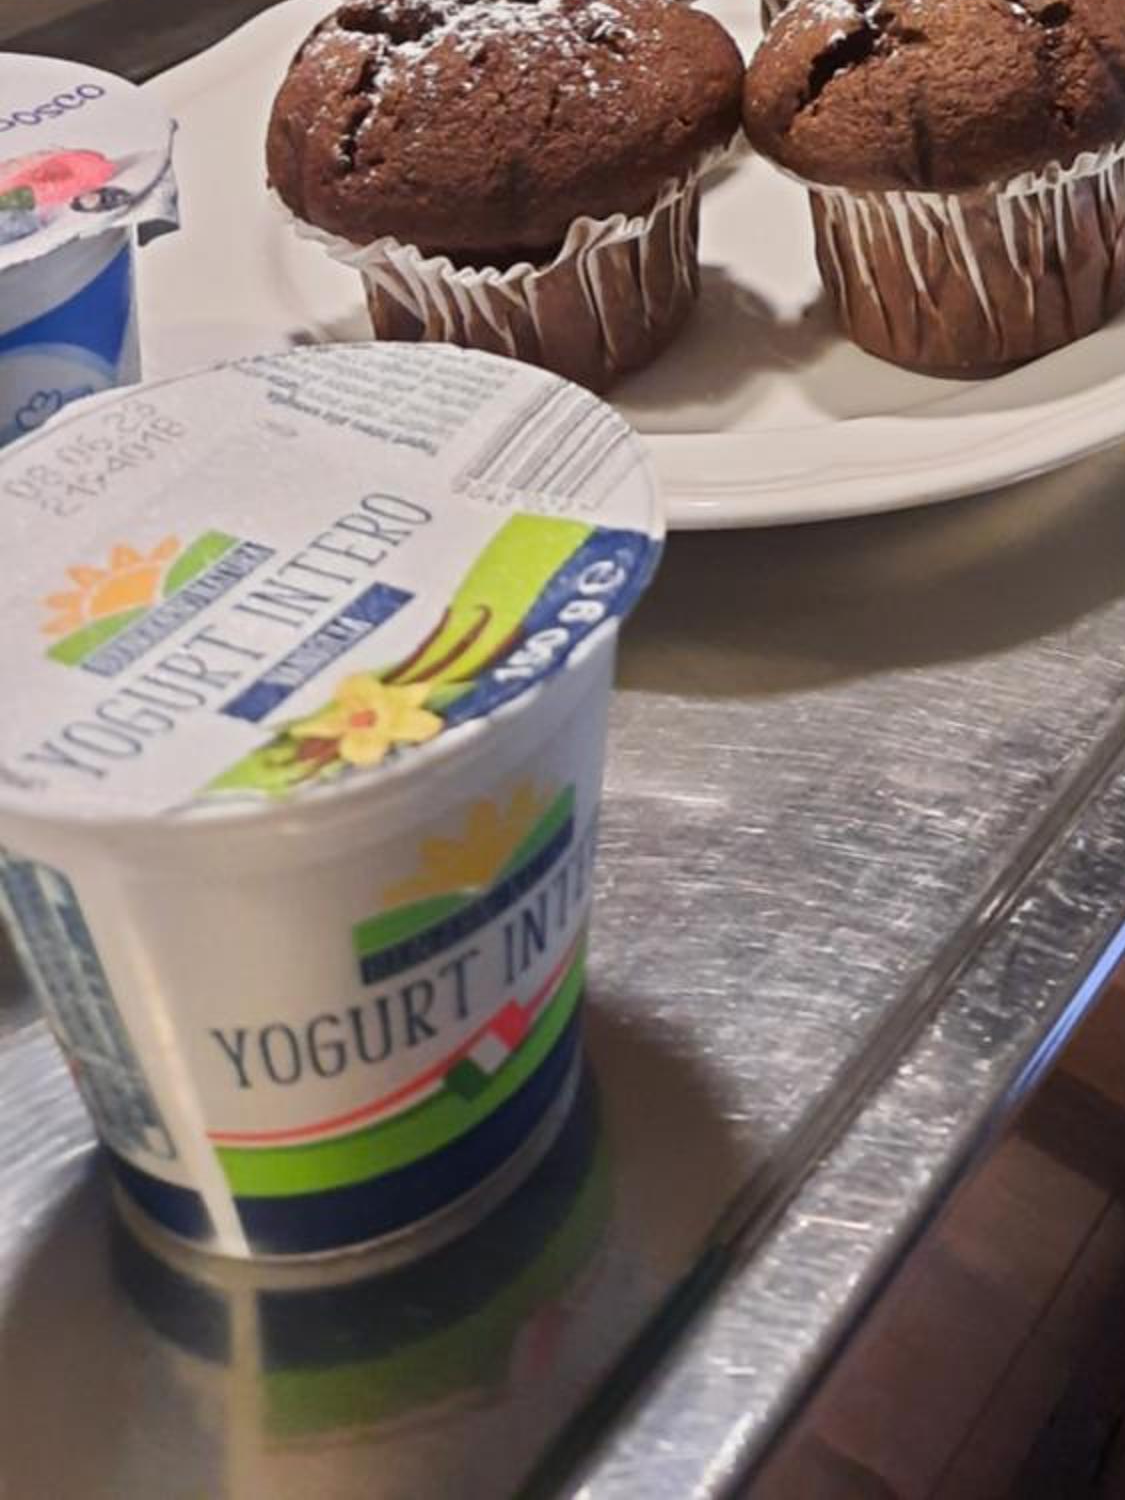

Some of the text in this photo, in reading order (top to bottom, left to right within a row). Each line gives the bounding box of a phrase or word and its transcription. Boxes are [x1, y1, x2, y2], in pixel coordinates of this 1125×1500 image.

[24, 625, 265, 779] YOGURT
[234, 491, 433, 629] INTERO
[209, 946, 482, 1090] YOGURT
